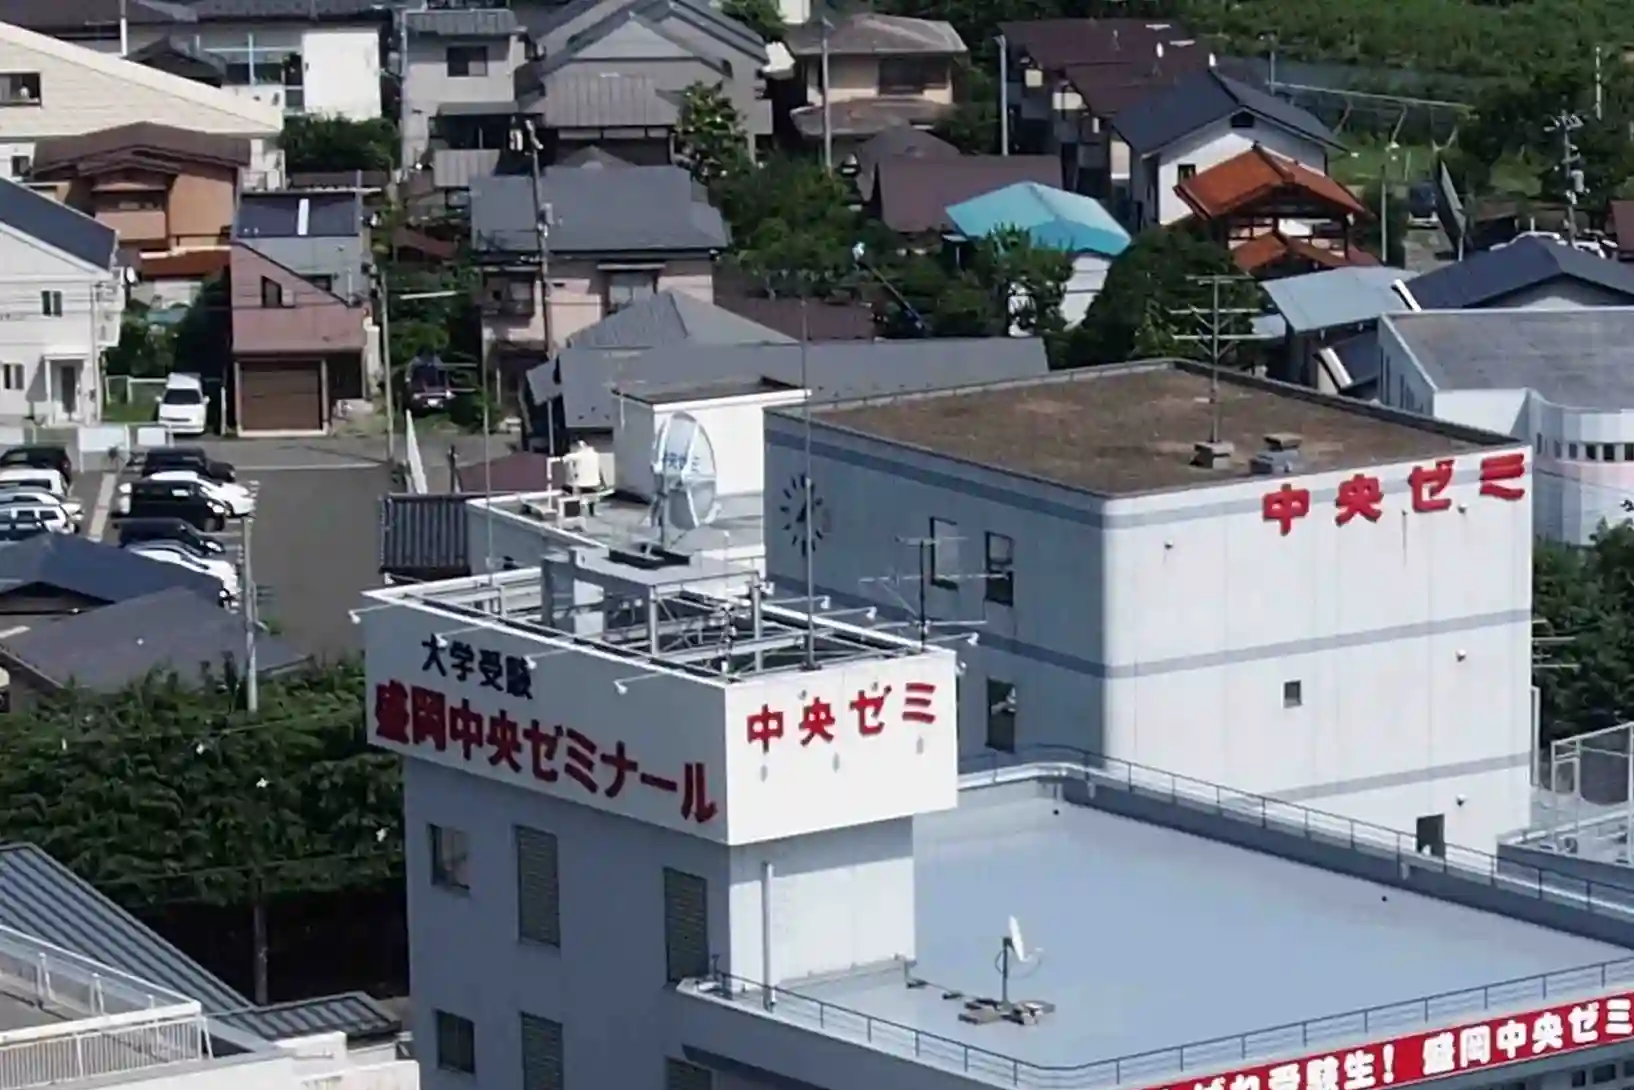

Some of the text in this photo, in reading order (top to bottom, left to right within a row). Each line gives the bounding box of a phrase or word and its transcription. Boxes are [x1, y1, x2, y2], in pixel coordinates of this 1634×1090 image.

[1262, 453, 1527, 536] 中央ゼミ
[421, 633, 533, 699] 大学受験
[375, 679, 718, 823] 盛岡中央ゼミナール
[746, 682, 937, 753] 中央ゼミ
